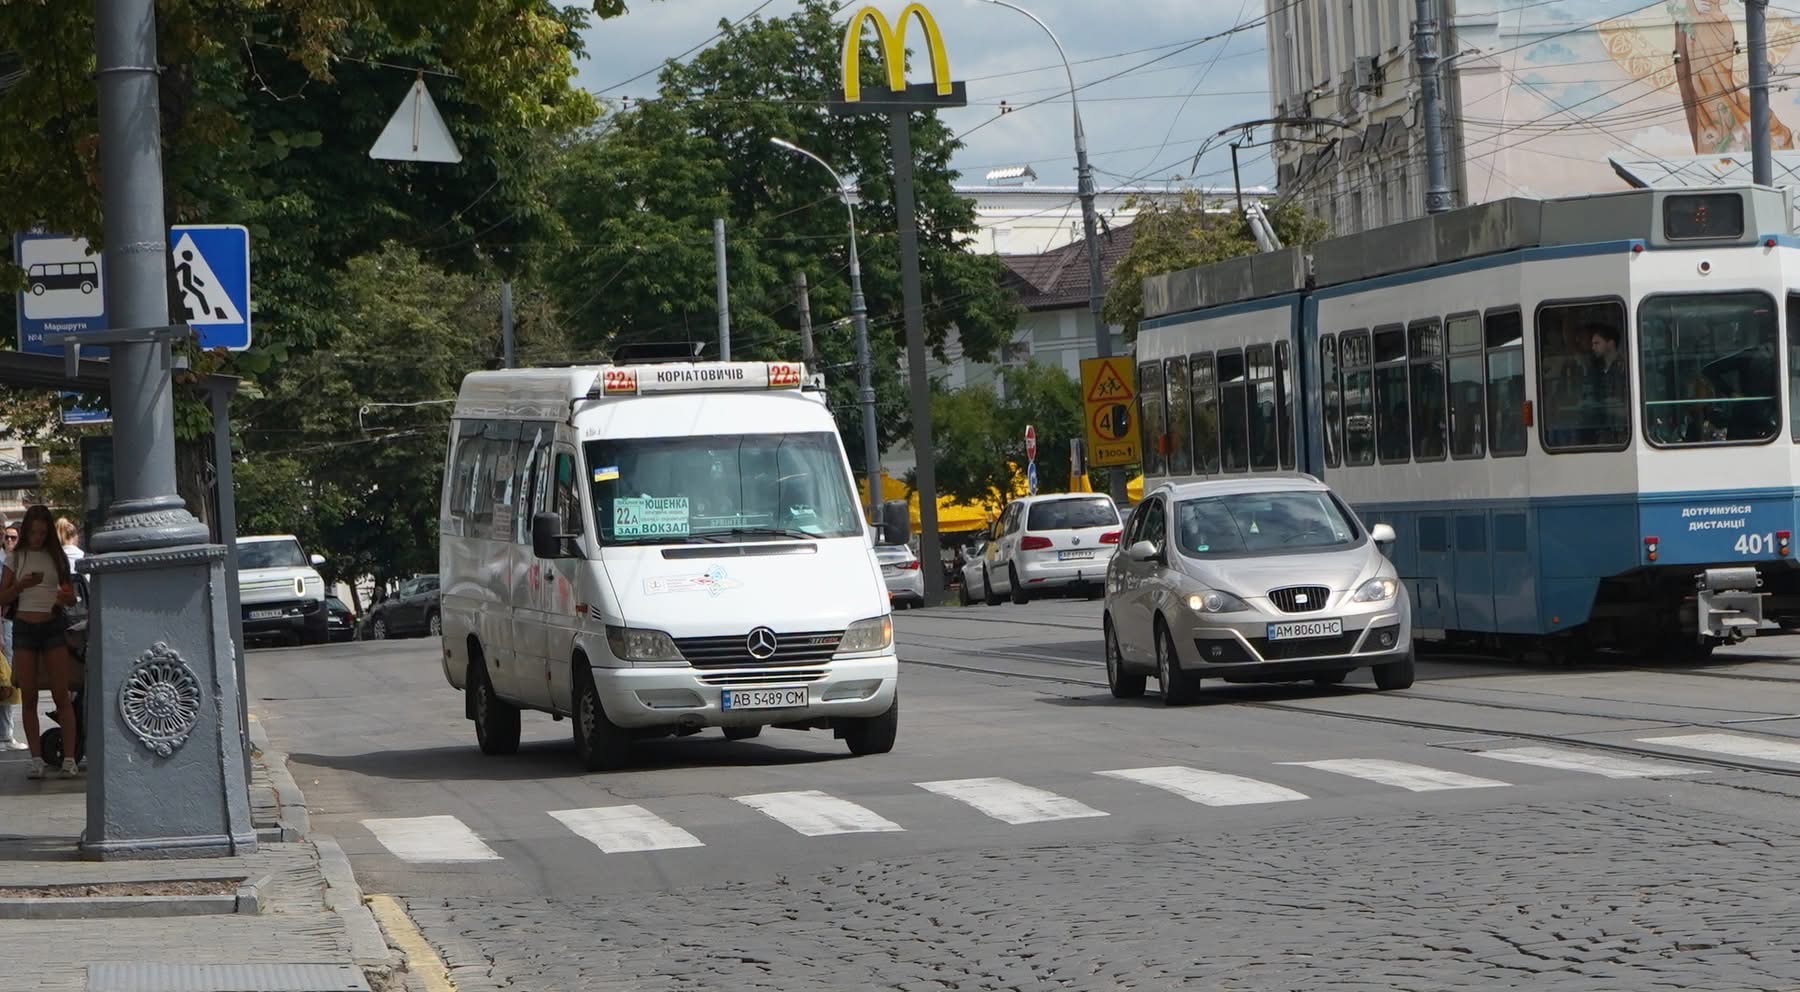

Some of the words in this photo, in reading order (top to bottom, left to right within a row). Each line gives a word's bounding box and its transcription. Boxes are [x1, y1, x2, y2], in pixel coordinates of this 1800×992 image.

[44, 322, 88, 332] Маршрути
[657, 368, 744, 383] КОРІАТОВИЧІВ
[645, 498, 688, 511] ЮЩЕНКА
[1681, 505, 1752, 517] ДОТРИМУЙСЯ
[642, 522, 688, 534] ВОКЗАЛ
[1688, 519, 1745, 531] ДИСТАНЦІЇ
[1734, 532, 1774, 555] 401
[1276, 625, 1292, 638] AM
[1294, 623, 1321, 635] 8060
[1323, 621, 1340, 634] HC
[733, 693, 751, 707] AB
[754, 692, 783, 706] 5489
[786, 690, 804, 705] CM
